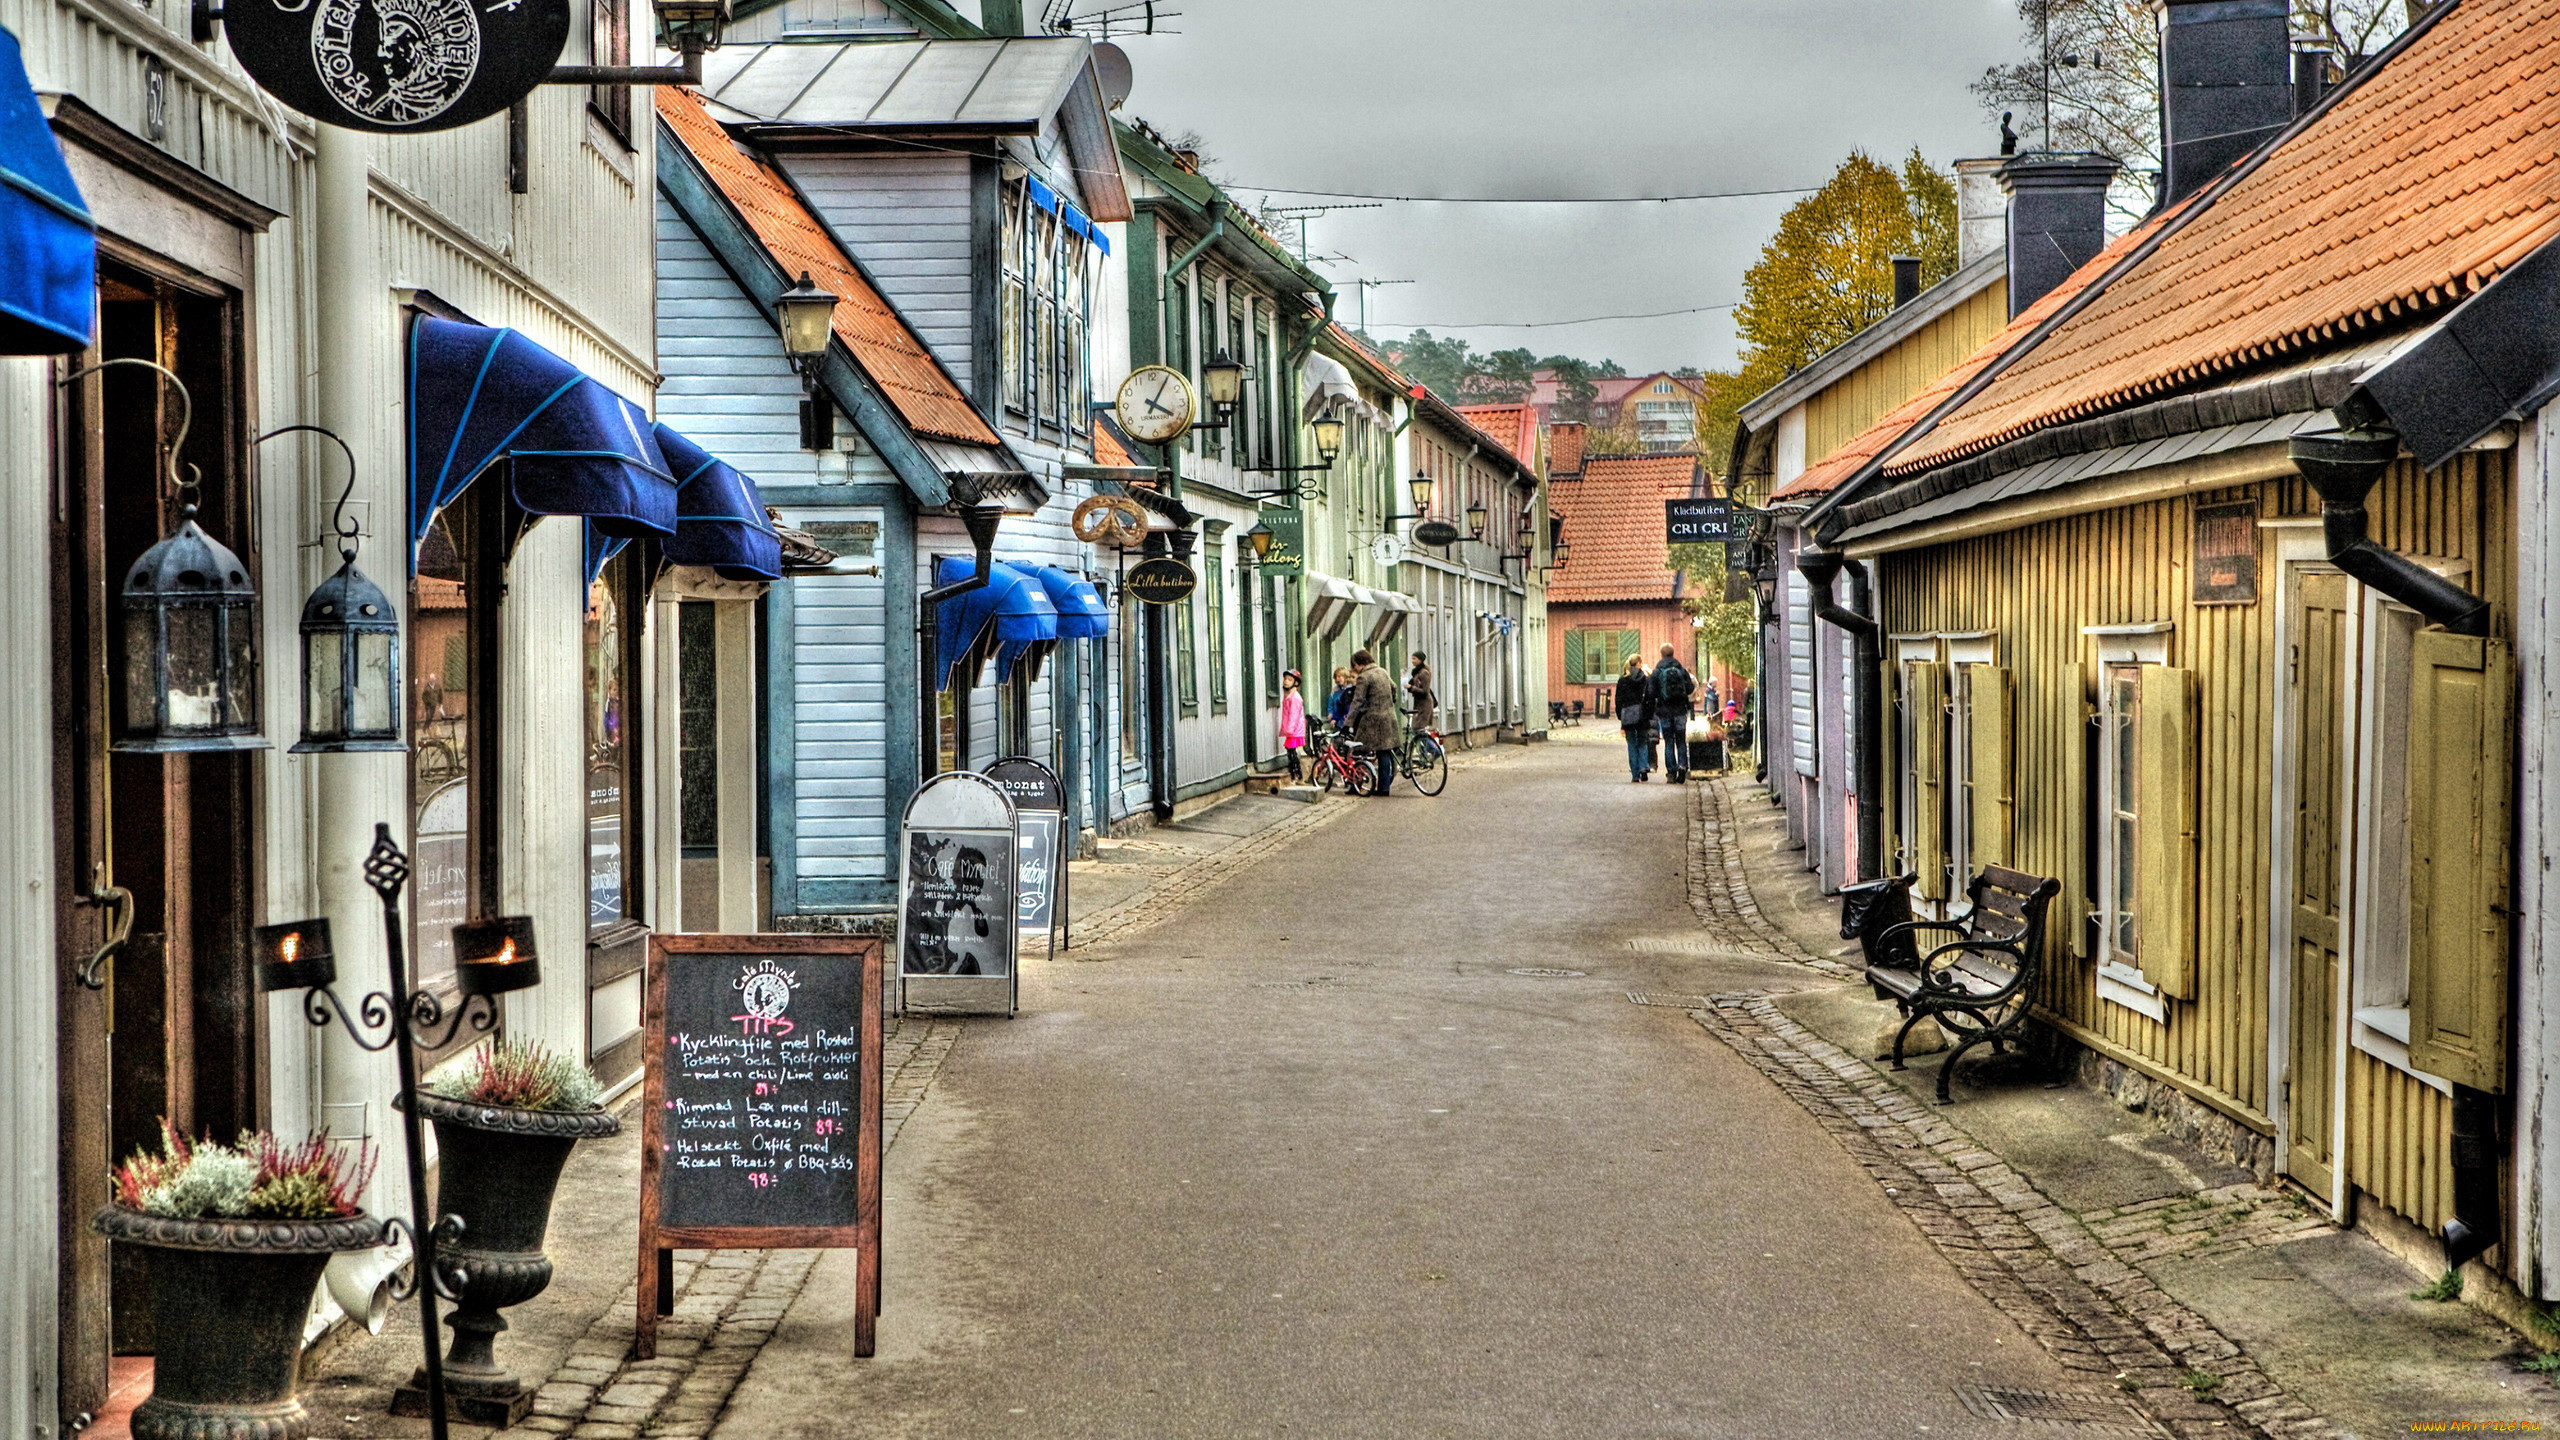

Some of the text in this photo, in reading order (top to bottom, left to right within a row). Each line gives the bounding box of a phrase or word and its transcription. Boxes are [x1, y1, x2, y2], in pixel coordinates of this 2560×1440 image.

[150, 71, 163, 126] 52
[1135, 377, 1142, 386] 11
[1148, 372, 1157, 381] 12
[1125, 388, 1133, 397] 10
[1174, 385, 1181, 393] 2
[1123, 403, 1129, 411] 9
[1179, 399, 1186, 407] 3
[1127, 416, 1134, 425] 8
[1138, 426, 1144, 435] 7
[1152, 429, 1159, 437] 6
[1264, 517, 1298, 525] SIGTUNA
[1671, 522, 1728, 535] CRI CRI
[1130, 574, 1193, 587] Lilla butiken
[928, 856, 955, 877] Café
[732, 960, 801, 990] Café Myntet
[731, 1014, 795, 1037] TIPS
[781, 1035, 809, 1050] med
[683, 1051, 859, 1069] Potatis och Rotfrukter
[695, 1070, 719, 1080] med
[723, 1071, 743, 1079] en
[676, 1096, 849, 1116] Rimmad Lax med dill-
[681, 1117, 736, 1129] stuvad
[749, 1114, 802, 1130] Potatis
[752, 1133, 793, 1156] Oxfilé
[800, 1137, 829, 1153] med
[731, 1154, 776, 1168] Potatis
